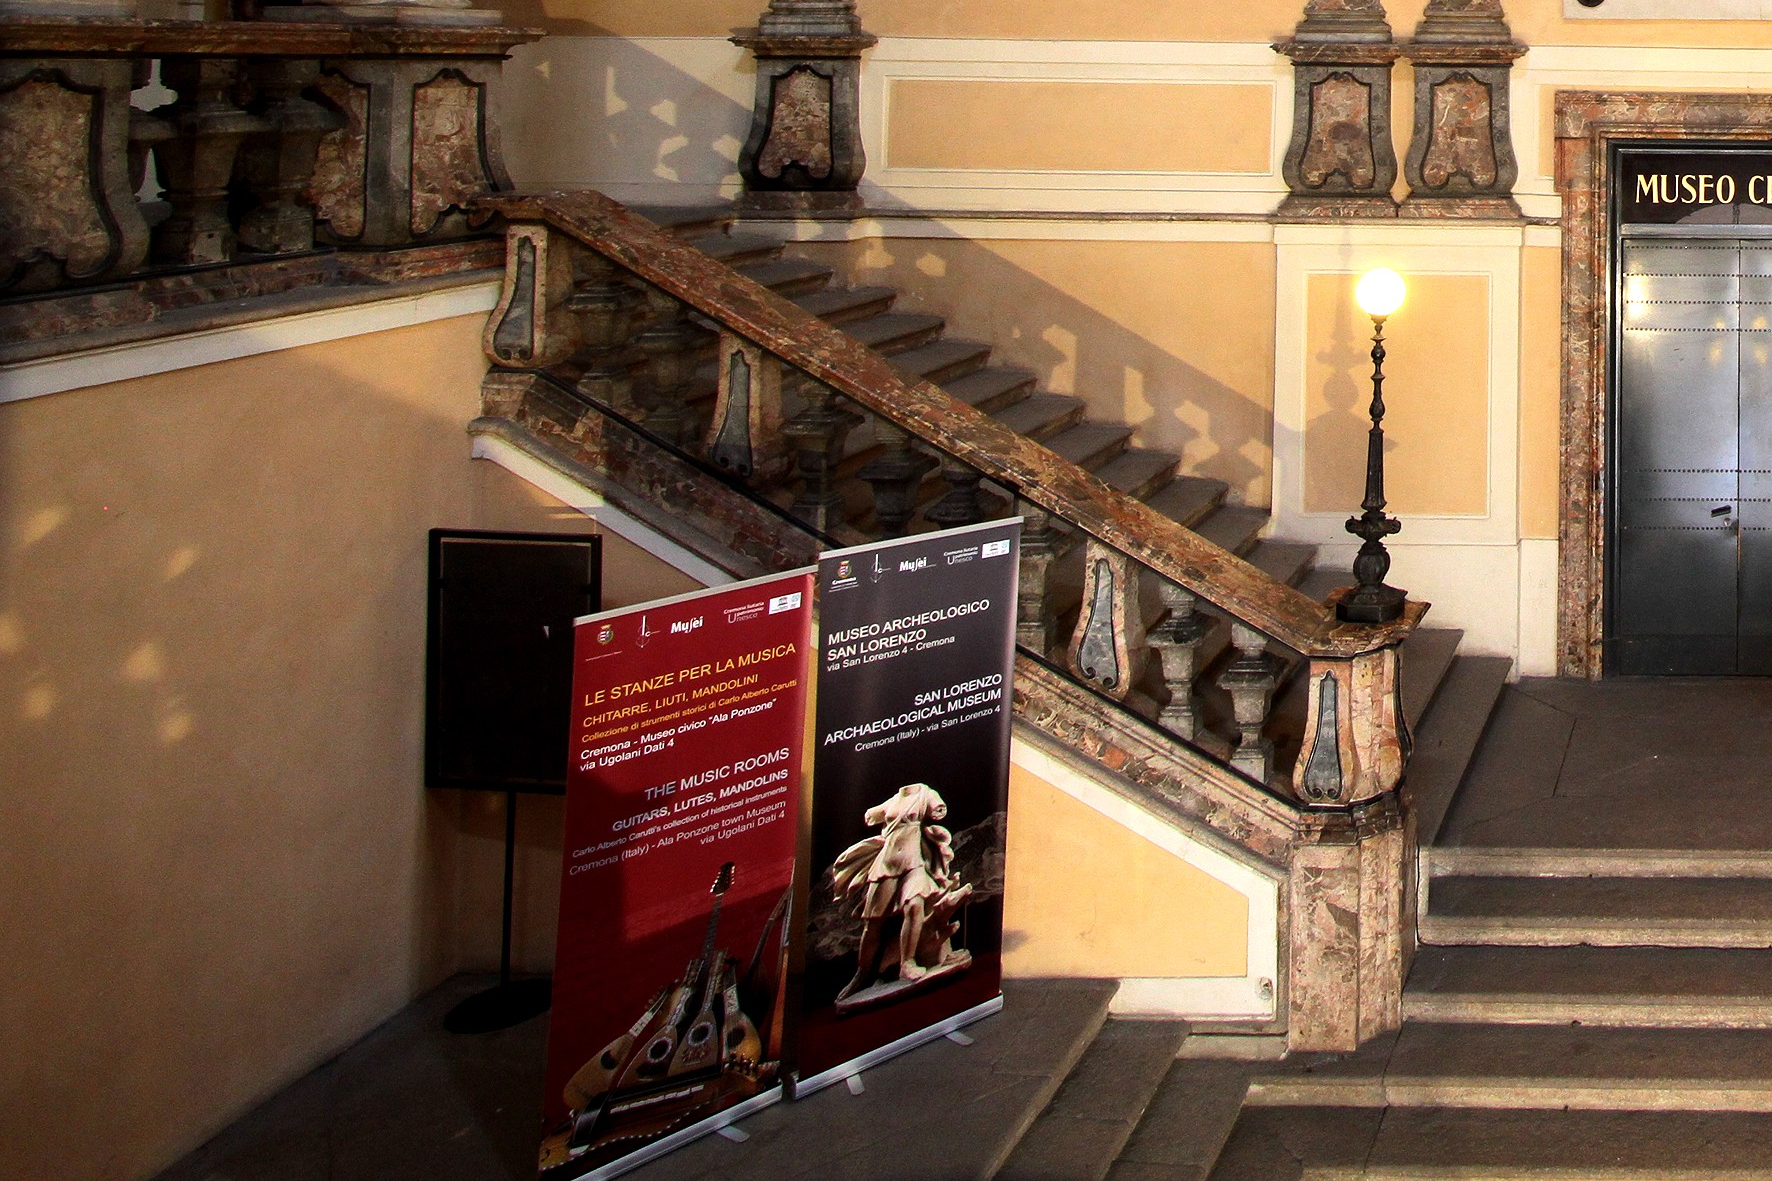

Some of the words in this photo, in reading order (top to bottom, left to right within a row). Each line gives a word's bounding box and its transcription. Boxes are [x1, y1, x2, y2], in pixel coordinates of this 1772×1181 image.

[1635, 174, 1736, 204] MUSEO
[826, 643, 856, 661] SAN
[859, 628, 926, 656] LORENZO
[827, 622, 880, 645] MUSEO
[881, 598, 989, 634] ARCHEOLOGICO
[584, 688, 605, 706] LE
[609, 671, 674, 699] STANZE
[678, 663, 711, 682] PER
[715, 658, 734, 673] LA
[737, 642, 795, 667] MUSICA
[826, 662, 840, 672] via
[841, 657, 861, 668] San
[862, 648, 900, 663] Lorenzo
[900, 645, 908, 654] 4
[914, 635, 955, 651] Cremona
[580, 725, 629, 743] Collezione
[629, 721, 639, 730] di
[640, 709, 680, 728] strumenti
[681, 702, 707, 716] storici
[707, 700, 716, 709] di
[717, 694, 740, 706] Carlo
[740, 687, 769, 700] Alberto
[770, 678, 797, 692] Carutti
[582, 701, 651, 727] CHITARRE,
[654, 691, 688, 709] LIUTI,
[691, 673, 758, 699] MANDOLINI
[913, 688, 941, 706] SAN
[942, 673, 1002, 698] LORENZO
[580, 740, 631, 760] Cremona
[639, 727, 675, 744] Museo
[676, 719, 706, 733] civico
[823, 703, 945, 746] ARCHAEOLOGICAL
[946, 687, 1001, 712] MUSEUM
[854, 735, 895, 752] Cremona
[896, 726, 920, 742] (Italy)
[925, 722, 939, 732] via
[940, 717, 958, 728] San
[959, 707, 993, 723] Lorenzo
[993, 704, 1000, 712] 4
[579, 757, 596, 771] via
[598, 746, 641, 766] Ugolani
[643, 739, 665, 755] Dati
[666, 737, 674, 747] 4
[643, 779, 676, 800] THE
[679, 764, 730, 791] MUSIC
[733, 746, 789, 774] ROOMS
[611, 805, 671, 831] GUITARS,
[673, 791, 717, 813] LUTES,
[718, 768, 788, 798] MANDOLINS
